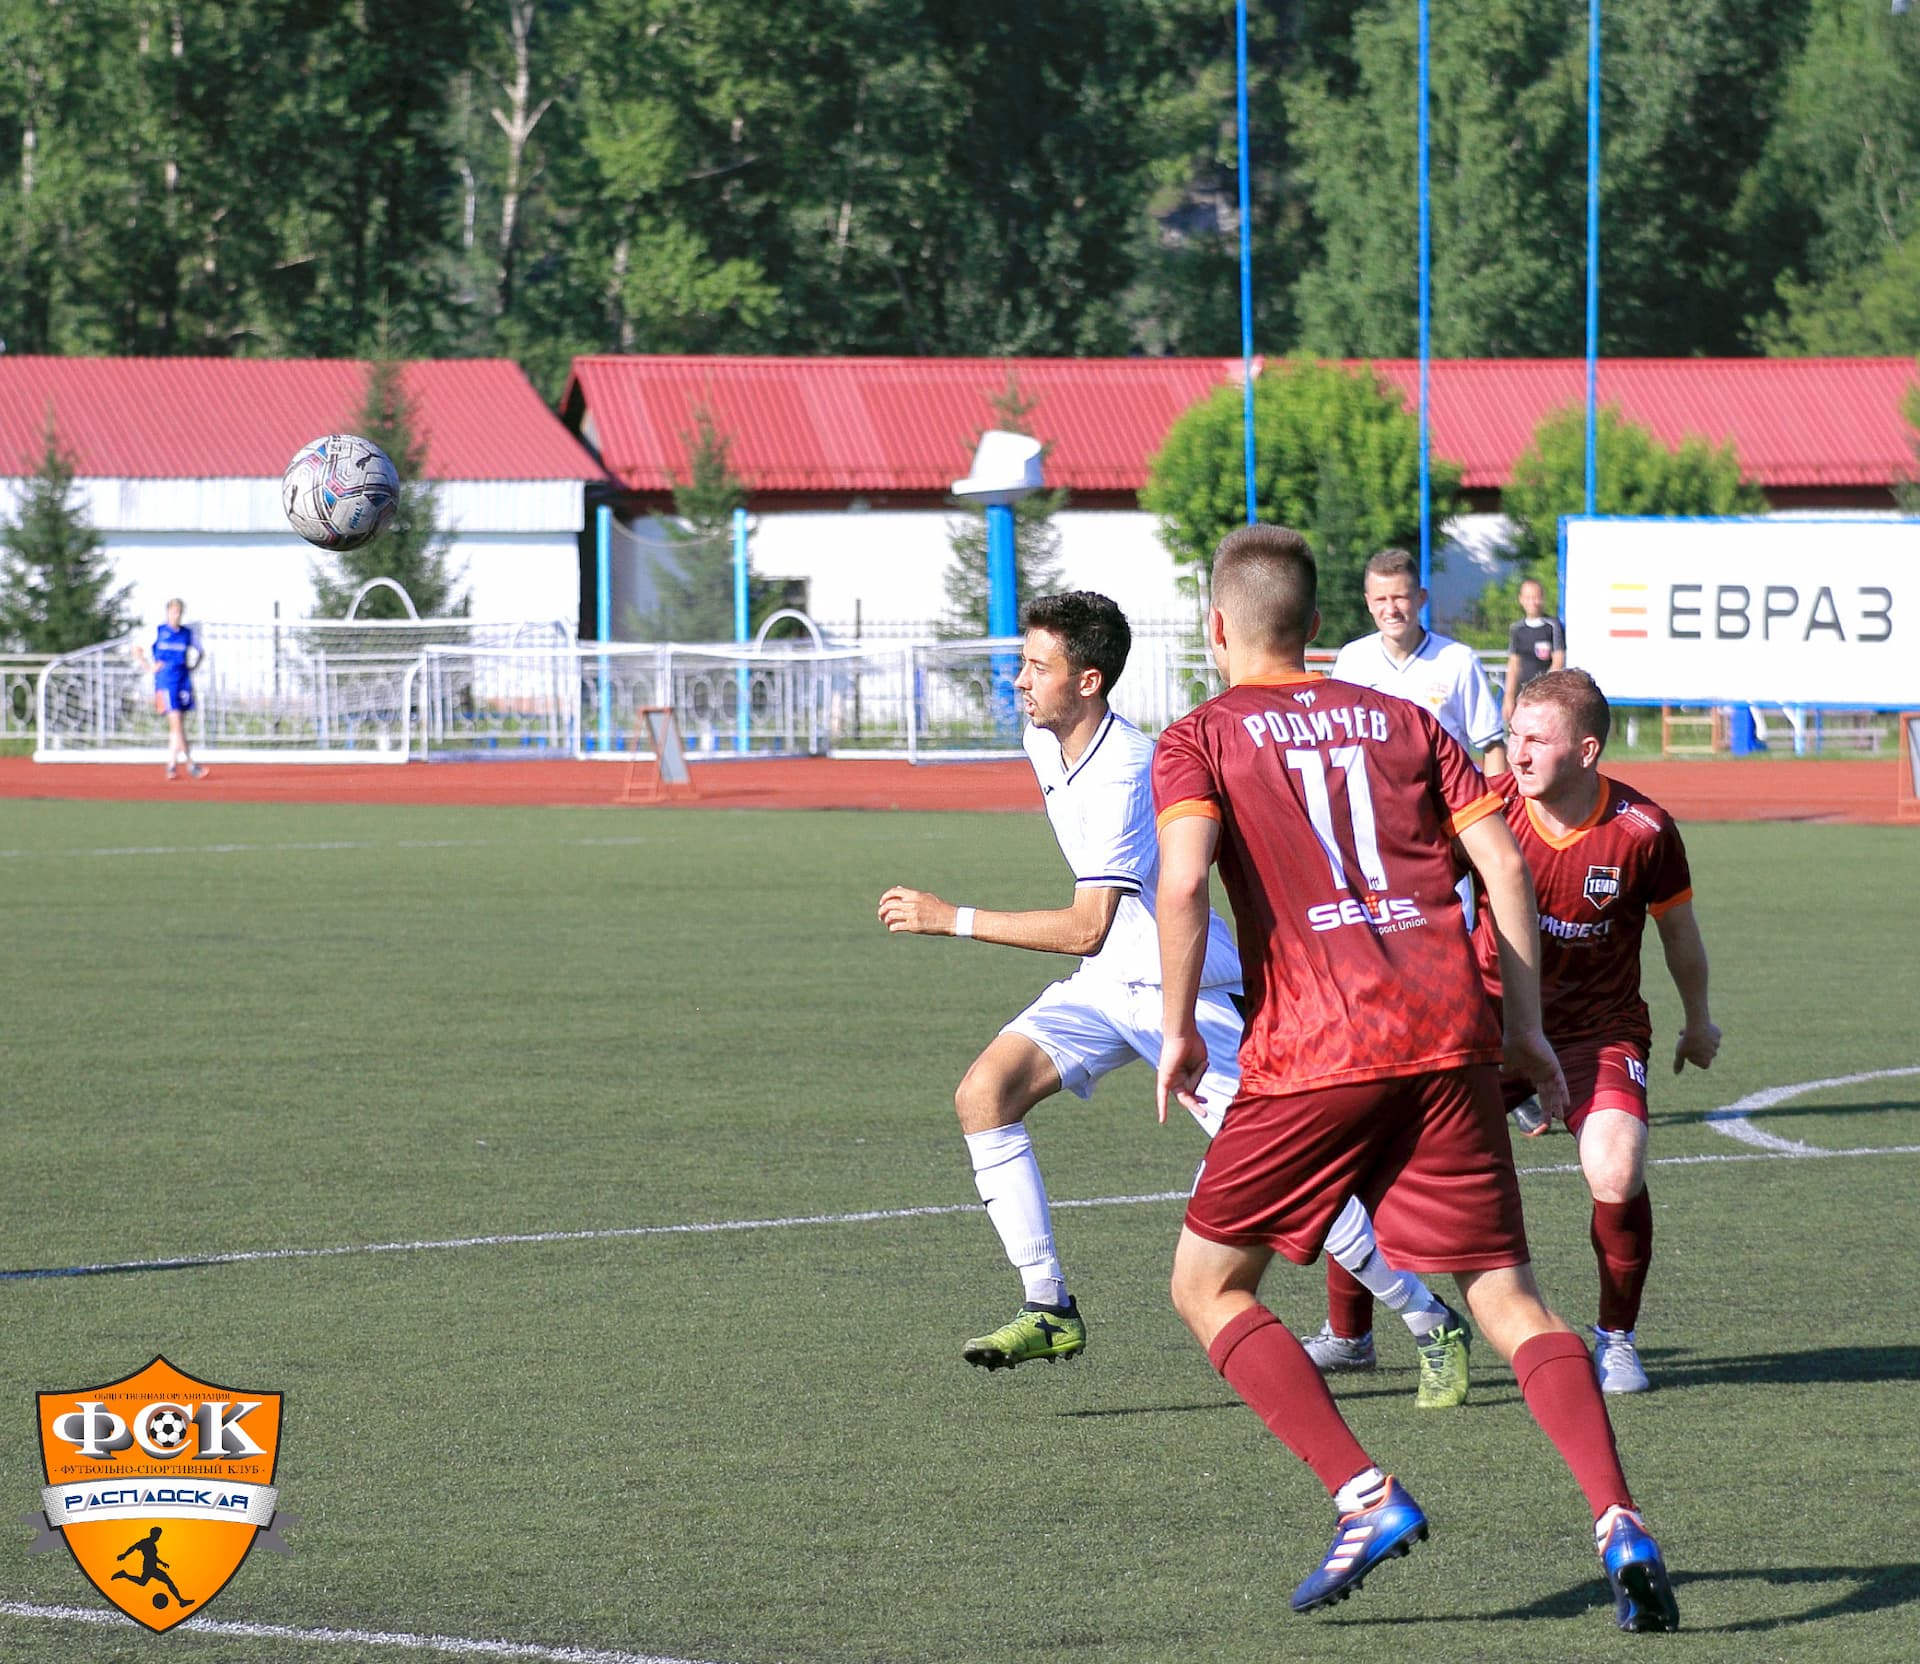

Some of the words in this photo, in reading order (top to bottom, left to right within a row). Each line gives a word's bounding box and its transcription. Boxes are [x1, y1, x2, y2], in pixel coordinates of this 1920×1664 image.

[1669, 584, 1893, 643] ЕВРАЗ
[1242, 705, 1389, 748] РОДИЧЕВ
[1285, 745, 1388, 892] 11
[1398, 917, 1427, 931] Union
